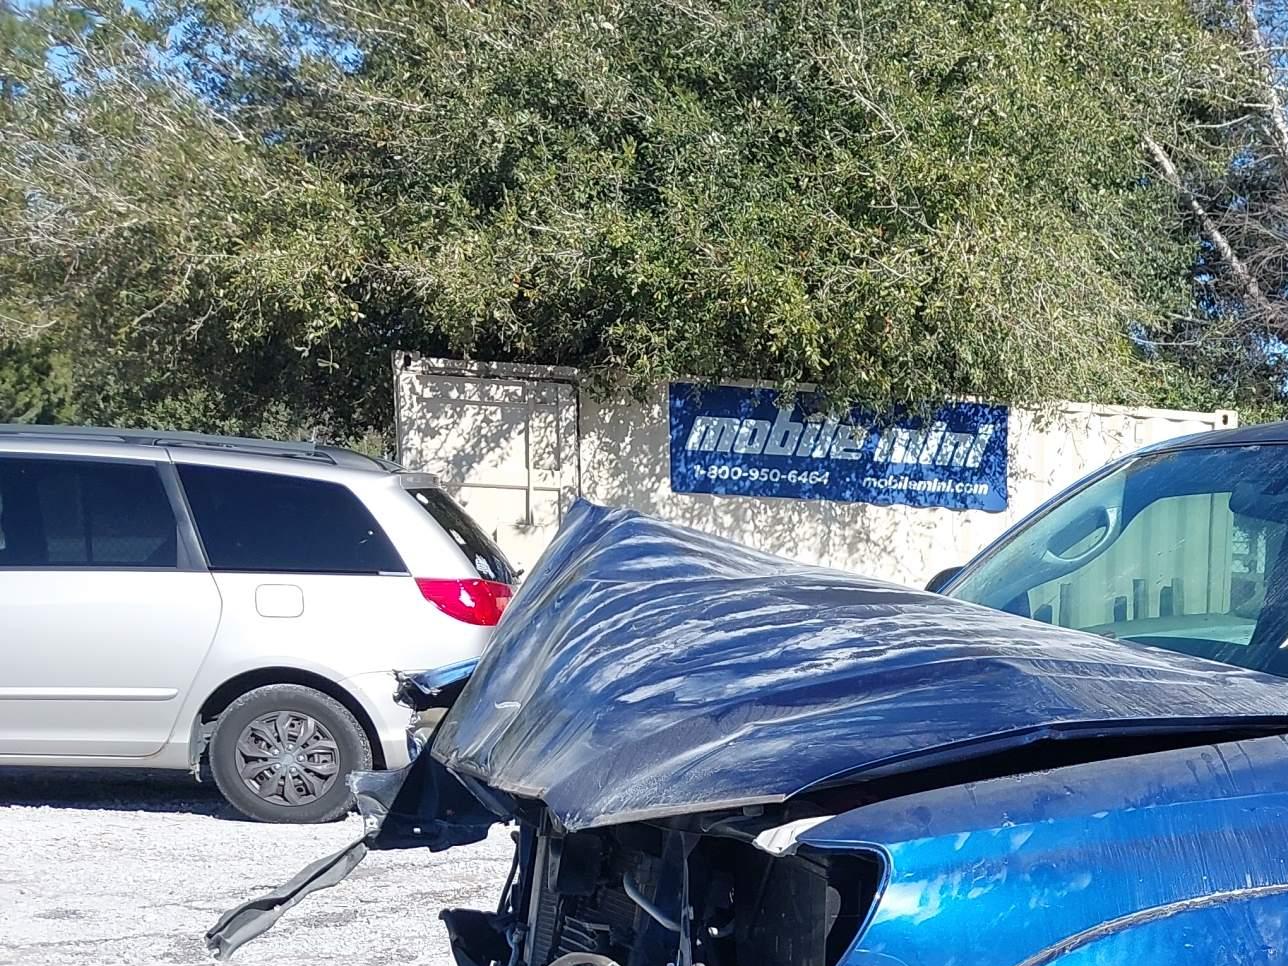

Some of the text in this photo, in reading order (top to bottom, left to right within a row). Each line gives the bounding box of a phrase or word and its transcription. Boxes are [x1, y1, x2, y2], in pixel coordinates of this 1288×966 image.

[685, 404, 993, 467] mobile mini
[694, 464, 830, 486] 1-800-950-6464
[863, 475, 989, 496] mobilemini.com
